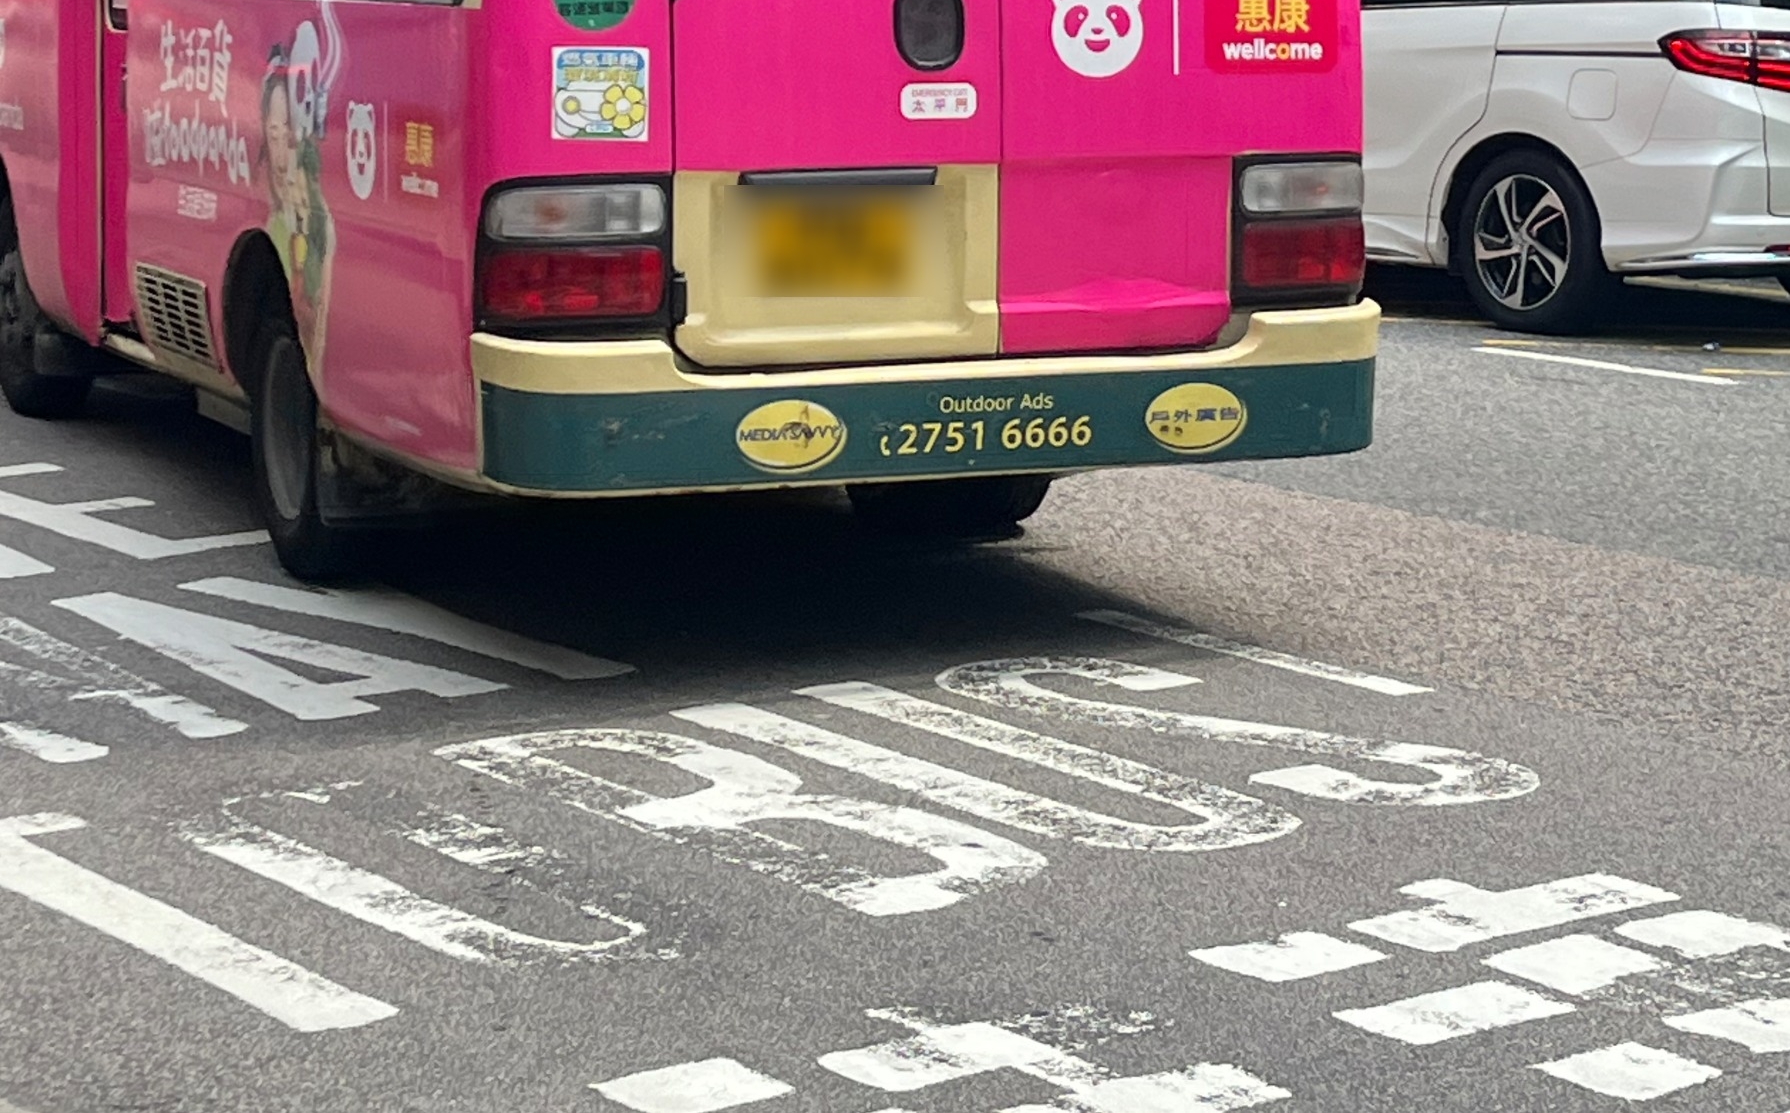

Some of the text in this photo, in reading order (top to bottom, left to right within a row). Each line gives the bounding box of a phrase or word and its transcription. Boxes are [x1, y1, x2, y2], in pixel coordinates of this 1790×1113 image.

[160, 19, 234, 118] 生活百貨
[1222, 38, 1323, 60] wellcome
[940, 392, 1054, 414] Outdoor Ads
[897, 415, 1093, 455] 2751 6666
[432, 656, 1541, 915] BUS
